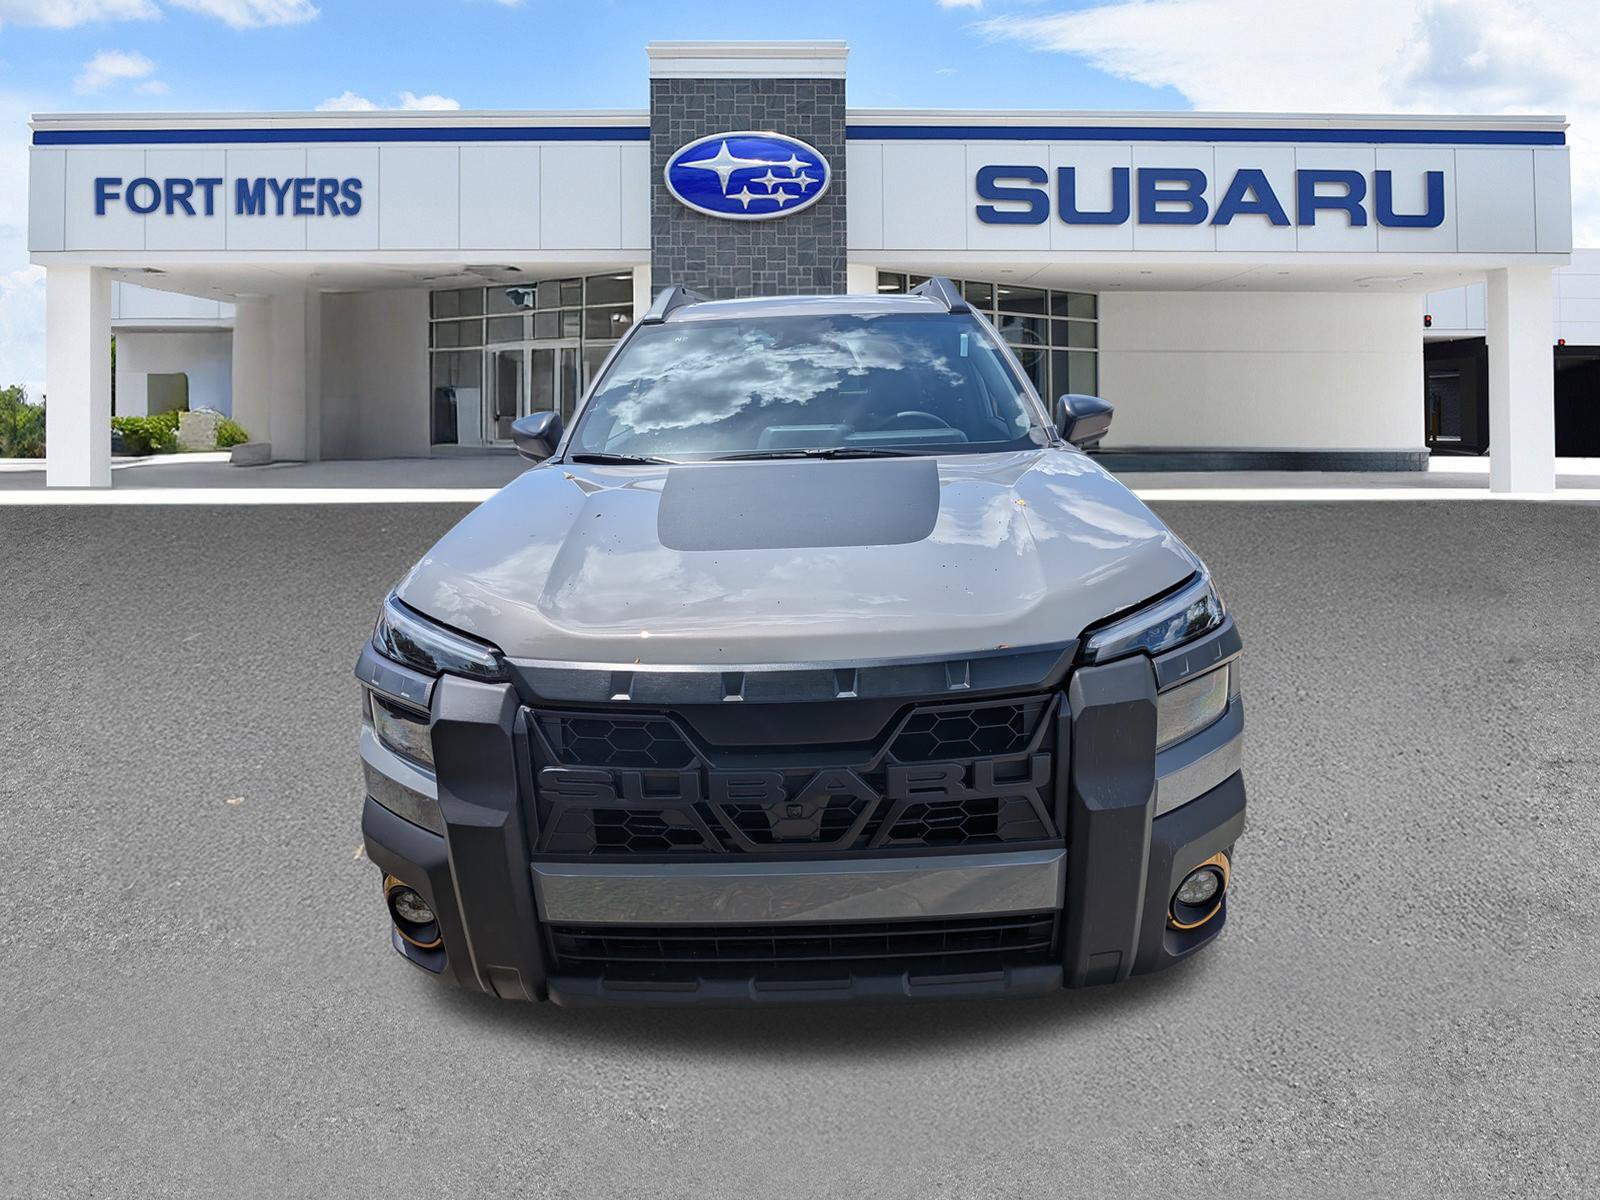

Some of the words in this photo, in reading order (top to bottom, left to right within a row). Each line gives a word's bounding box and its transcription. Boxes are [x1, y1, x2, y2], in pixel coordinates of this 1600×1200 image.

[94, 177, 223, 216] FORT
[235, 177, 363, 217] MYERS
[976, 165, 1446, 228] SUBARU
[538, 753, 1052, 803] SUBARU
